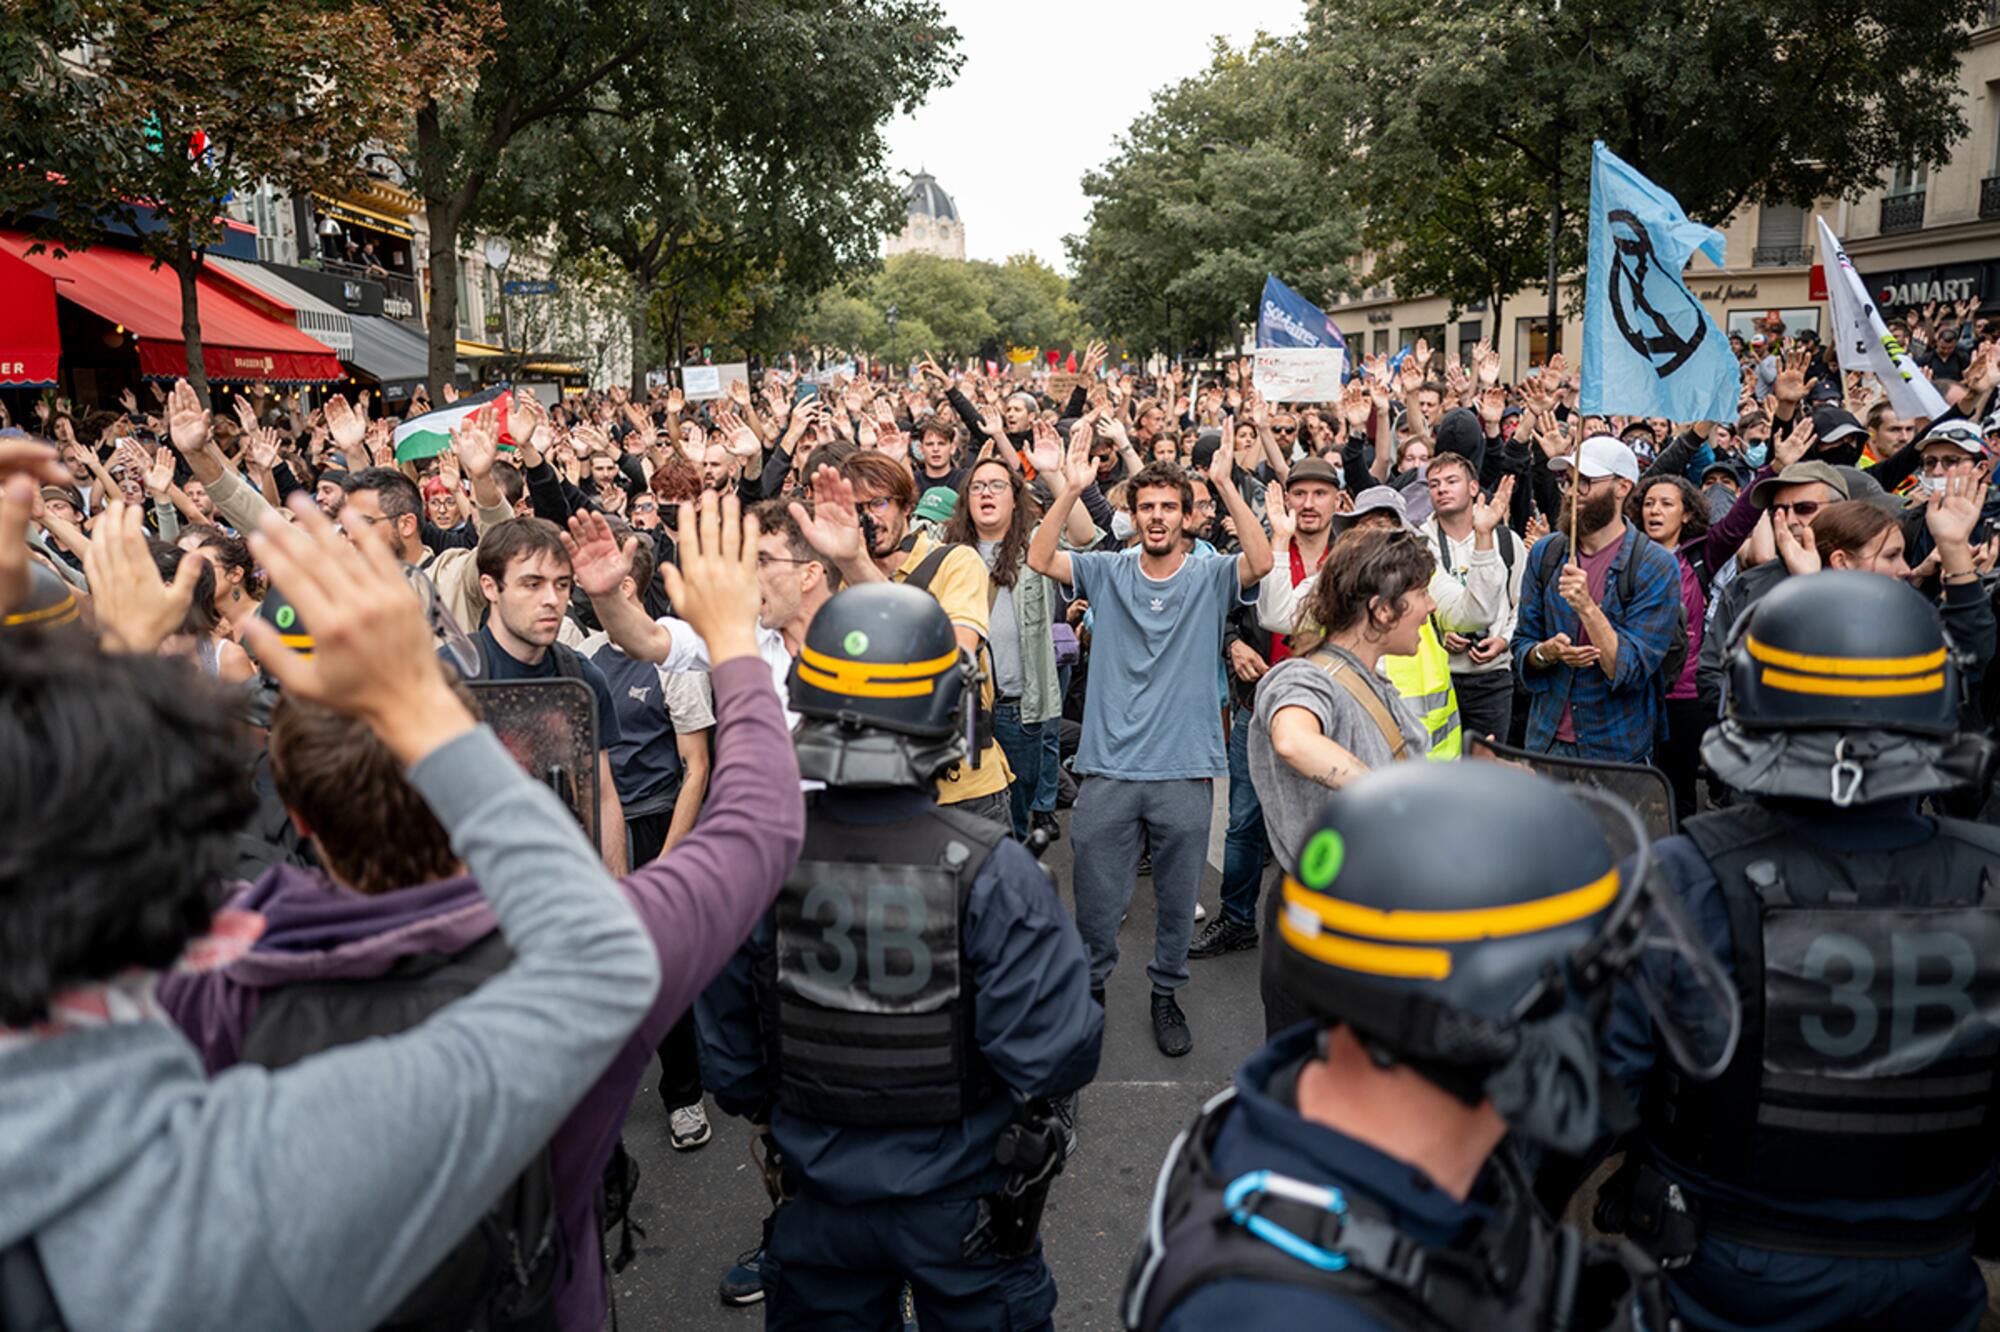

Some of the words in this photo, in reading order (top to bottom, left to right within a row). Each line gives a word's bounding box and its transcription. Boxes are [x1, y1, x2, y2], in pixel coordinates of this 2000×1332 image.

[1700, 285, 1722, 300] and
[1721, 283, 1757, 304] friends
[1881, 279, 1975, 307] DAMART
[1, 362, 25, 374] ER
[802, 882, 933, 996] 3B
[1801, 932, 1976, 1057] 3B
